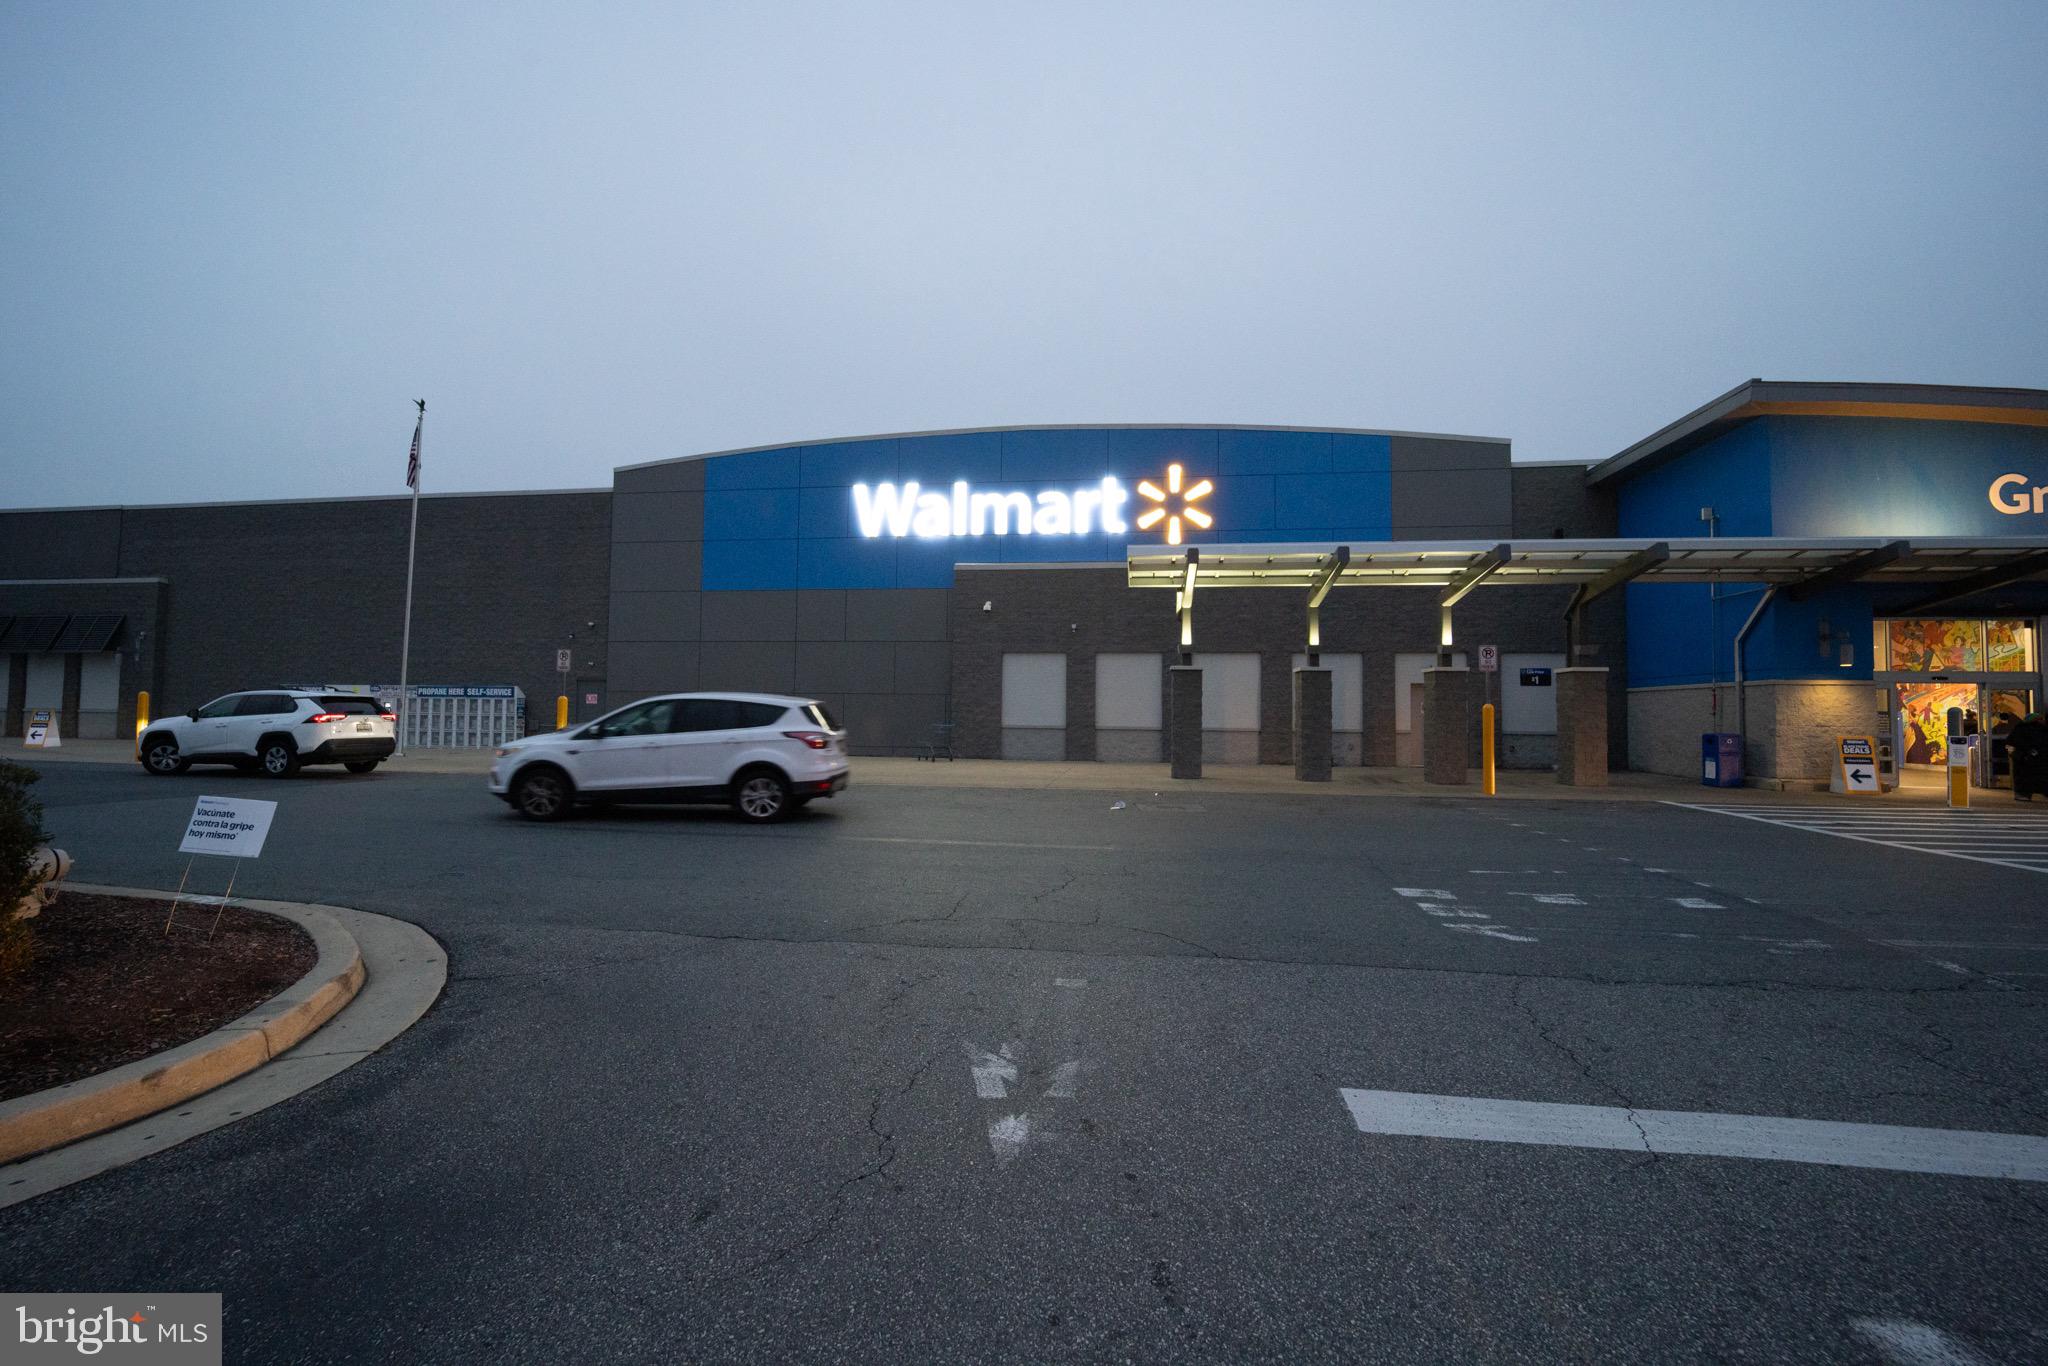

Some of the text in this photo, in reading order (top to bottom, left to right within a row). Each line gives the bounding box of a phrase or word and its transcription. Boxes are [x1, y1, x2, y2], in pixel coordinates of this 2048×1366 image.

[853, 476, 1127, 537] Walmart
[418, 687, 512, 696] PROPANE HERE SELF-SERVICE
[197, 808, 235, 818] Vacúnate
[193, 819, 254, 831] contra la gripe
[188, 829, 204, 839] hoy
